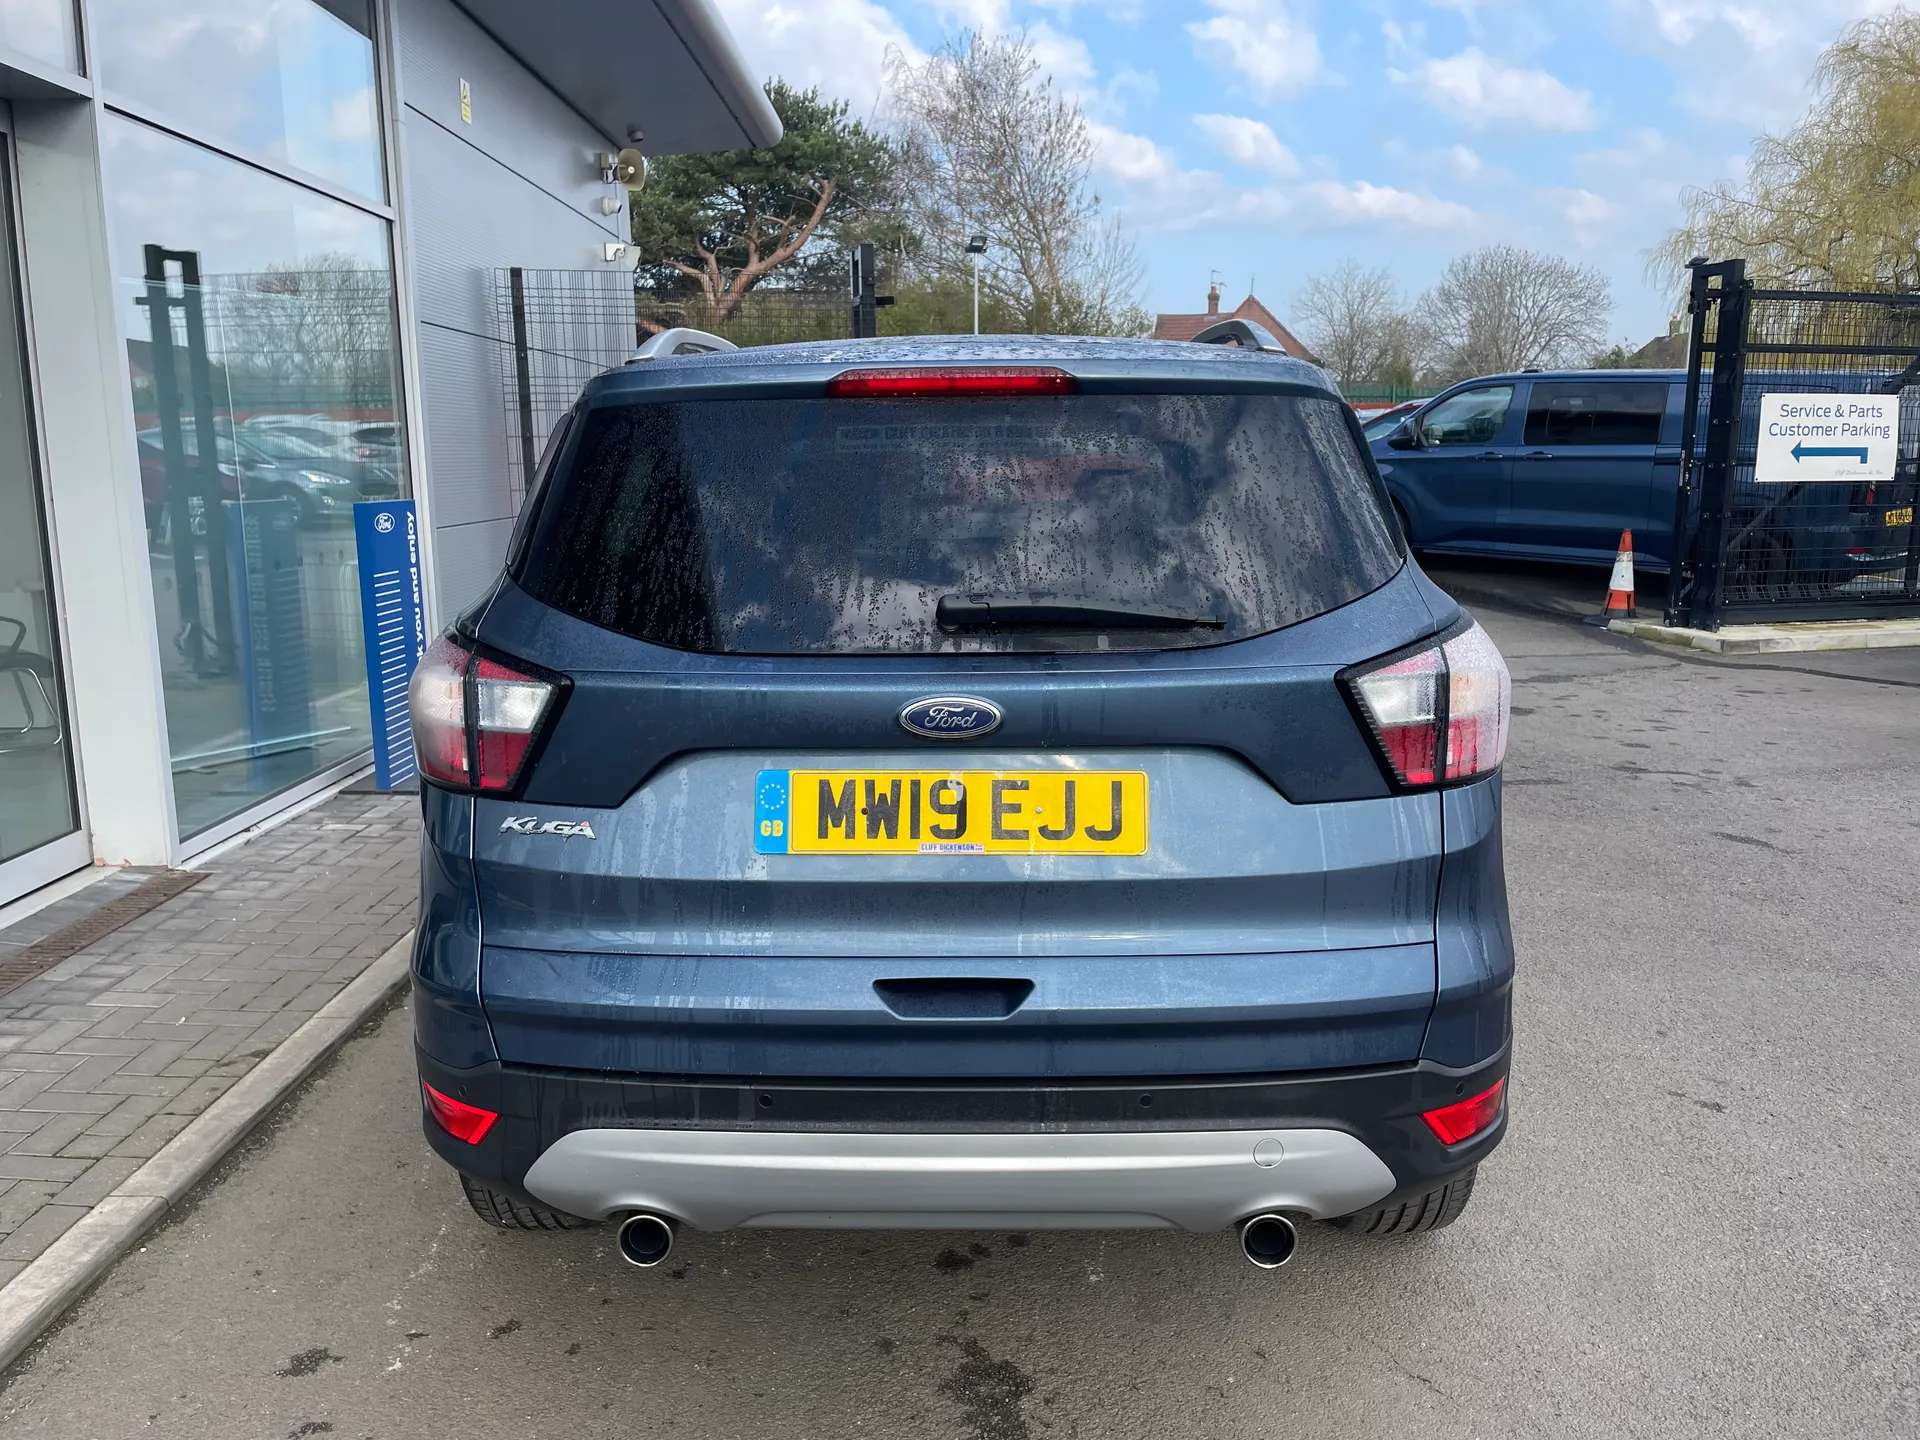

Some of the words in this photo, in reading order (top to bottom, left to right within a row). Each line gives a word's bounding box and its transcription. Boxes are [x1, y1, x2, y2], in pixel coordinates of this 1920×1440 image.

[1779, 403, 1832, 418] Service
[1834, 404, 1845, 418] &
[1849, 404, 1883, 418] Parts
[1768, 422, 1838, 437] Customer
[1841, 423, 1890, 439] Parking
[377, 514, 393, 531] Ford
[406, 511, 417, 564] enjoy
[410, 567, 419, 604] and
[414, 607, 424, 643] you
[924, 706, 978, 728] Ford
[817, 779, 968, 840] MW19
[991, 780, 1123, 841] EJJ
[499, 816, 596, 840] KUGA
[760, 820, 784, 837] GB
